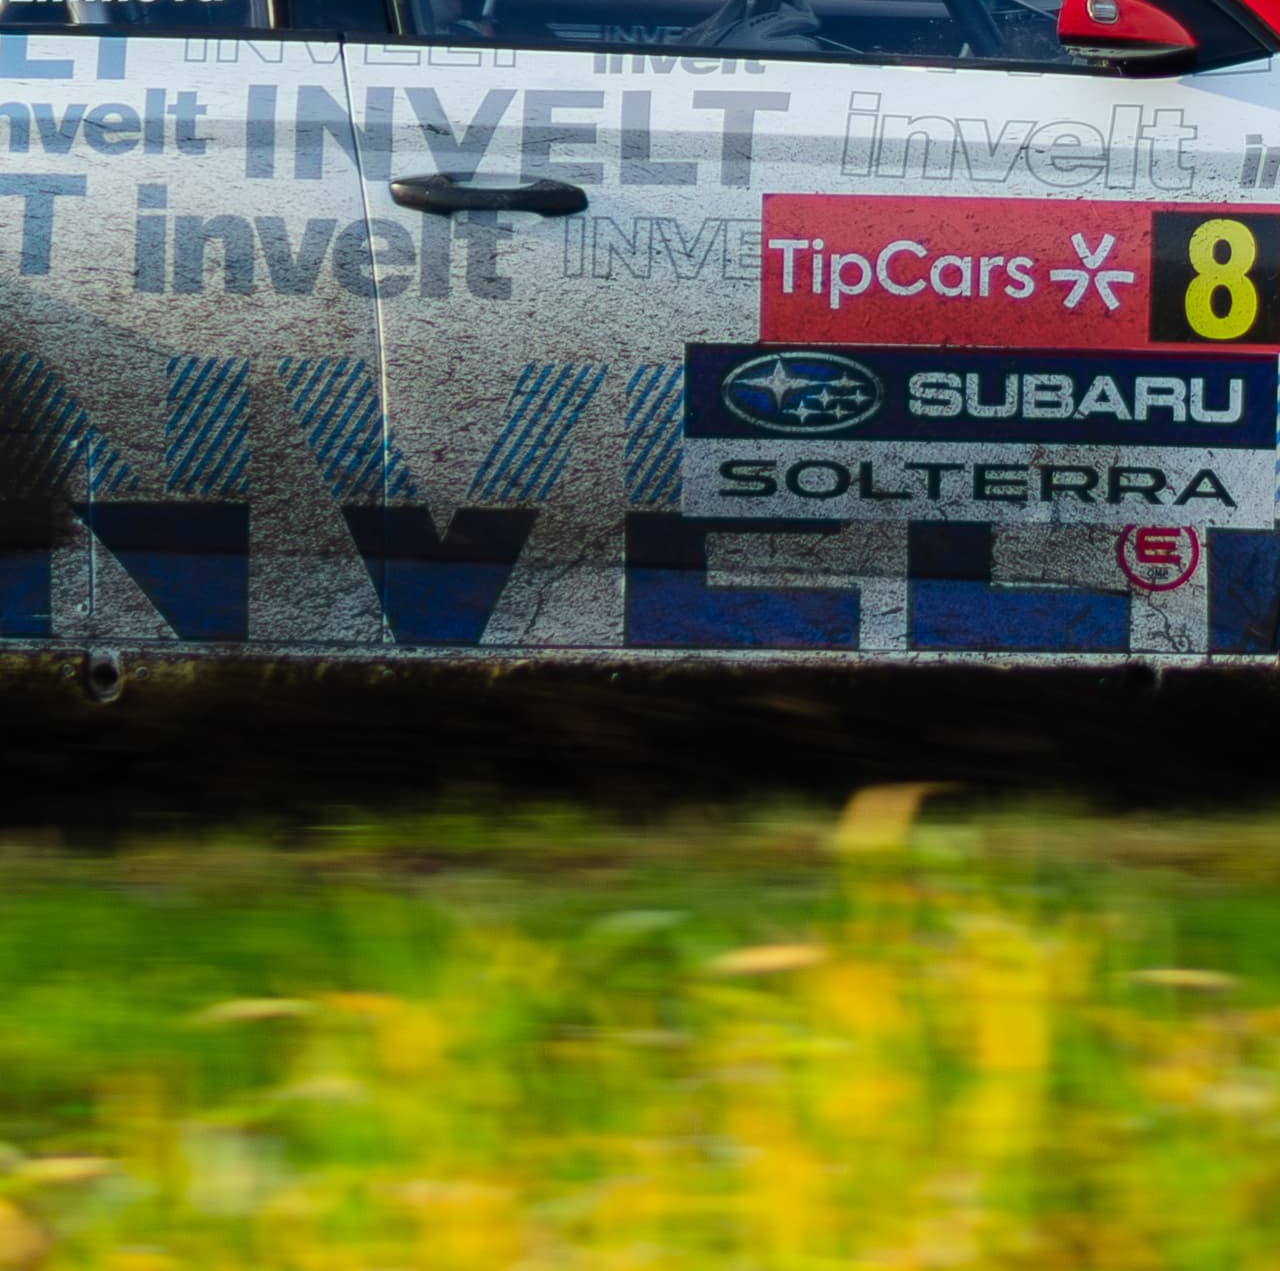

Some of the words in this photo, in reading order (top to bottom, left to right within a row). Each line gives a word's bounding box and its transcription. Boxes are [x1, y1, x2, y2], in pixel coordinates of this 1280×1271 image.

[246, 84, 791, 187] INVELT
[840, 90, 1199, 191] invelt
[132, 183, 514, 301] invelt
[768, 238, 1036, 310] TipCars
[1184, 218, 1259, 341] 8
[907, 371, 1244, 425] SUBARU
[718, 458, 1239, 508] SOLTERRA
